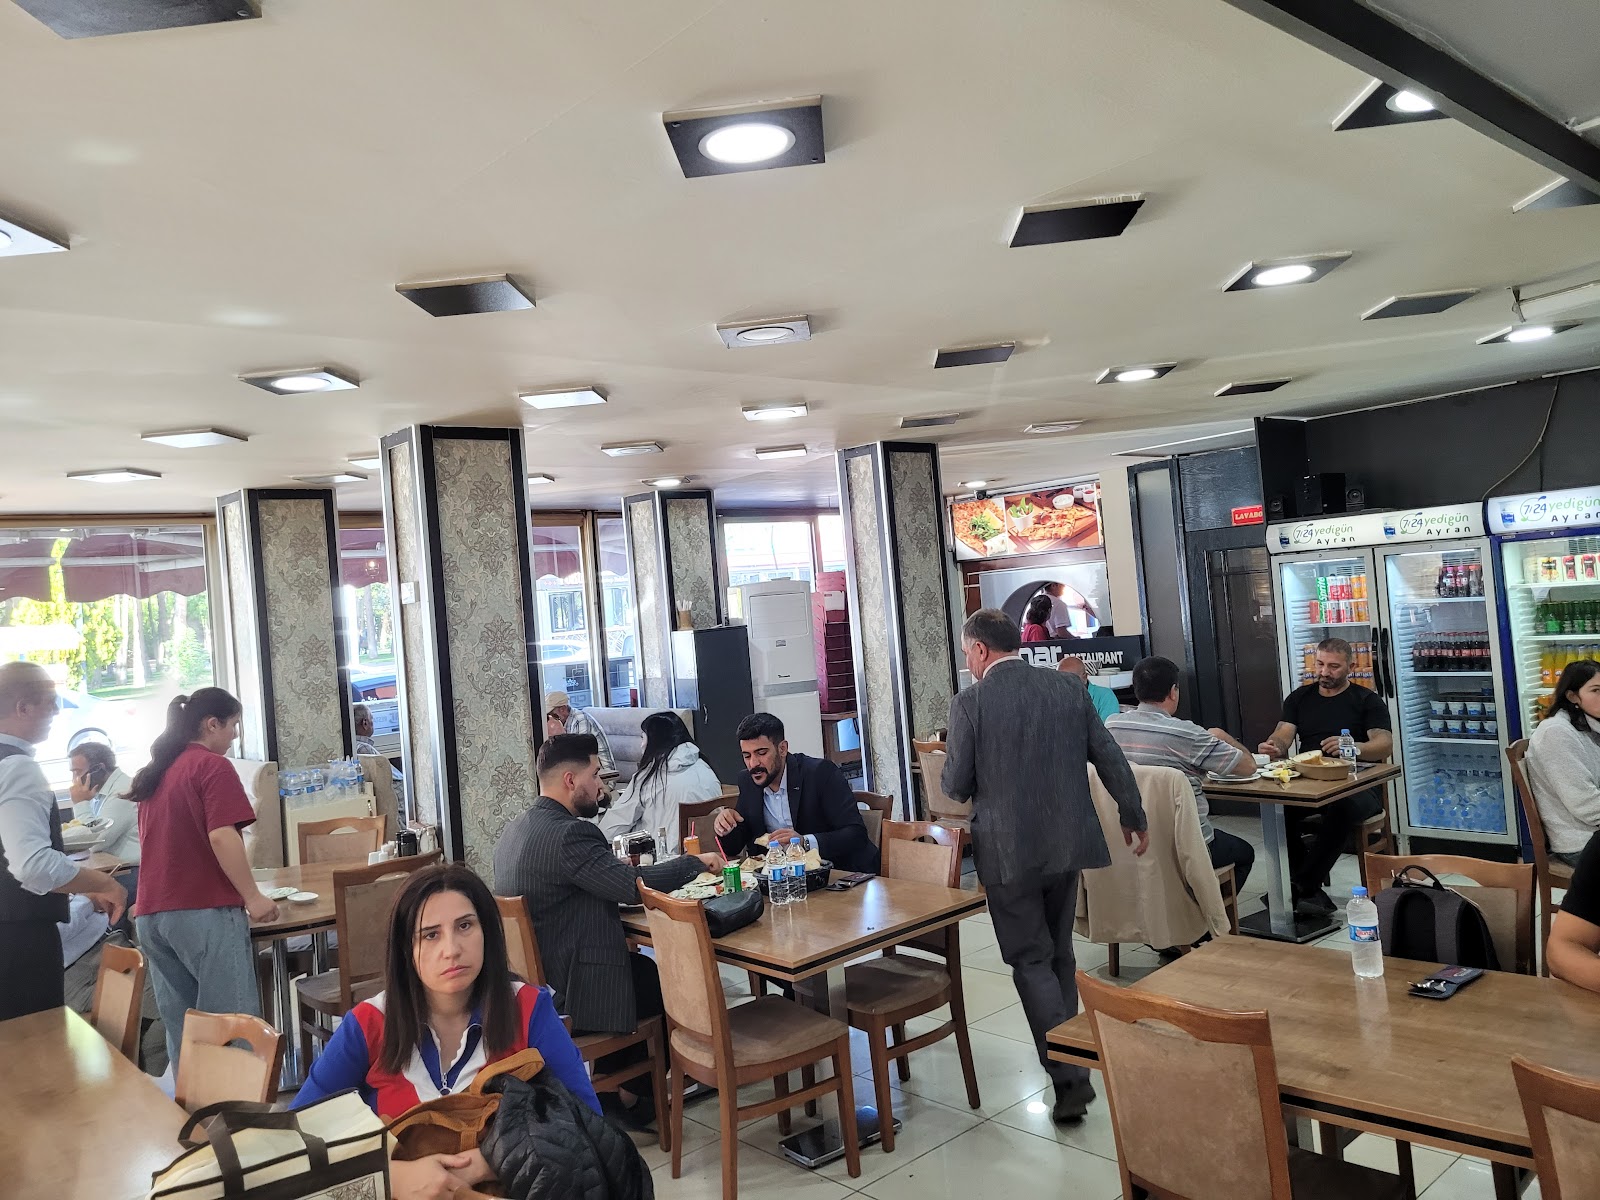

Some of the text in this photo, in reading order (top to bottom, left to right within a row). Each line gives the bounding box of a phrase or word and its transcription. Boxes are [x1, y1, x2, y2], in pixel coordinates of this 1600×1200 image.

[1234, 511, 1263, 521] LAVABO
[1424, 513, 1469, 526] yedigün
[1551, 511, 1600, 523] Ayran
[1314, 524, 1353, 538] yedigün
[1426, 526, 1471, 536] Ayran
[1316, 536, 1356, 545] Ayran
